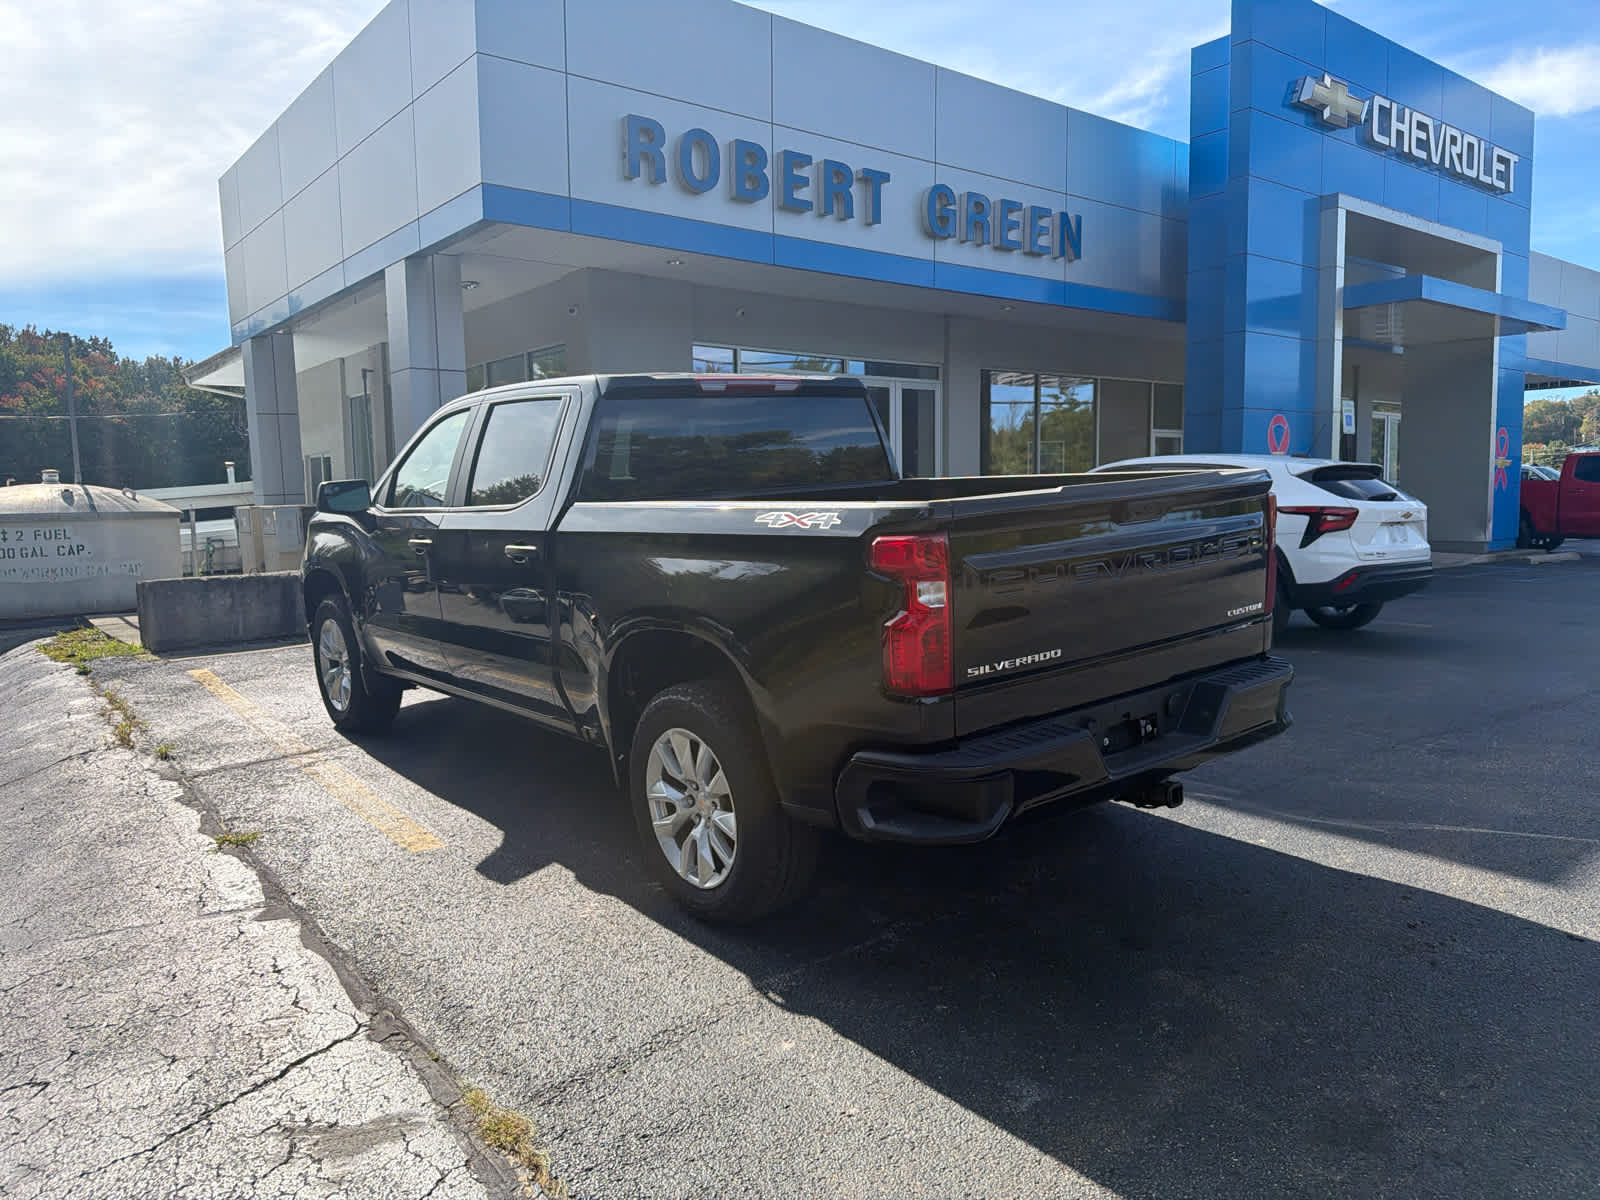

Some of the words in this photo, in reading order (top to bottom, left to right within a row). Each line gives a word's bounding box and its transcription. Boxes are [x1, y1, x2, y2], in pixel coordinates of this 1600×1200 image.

[1372, 95, 1519, 193] CHEVROLET
[622, 113, 891, 226] ROBERT
[924, 183, 1083, 261] GREEN
[16, 530, 24, 541] 2
[33, 528, 71, 541] FUEL
[20, 546, 48, 558] GAL
[967, 649, 1062, 678] SILVERADO
